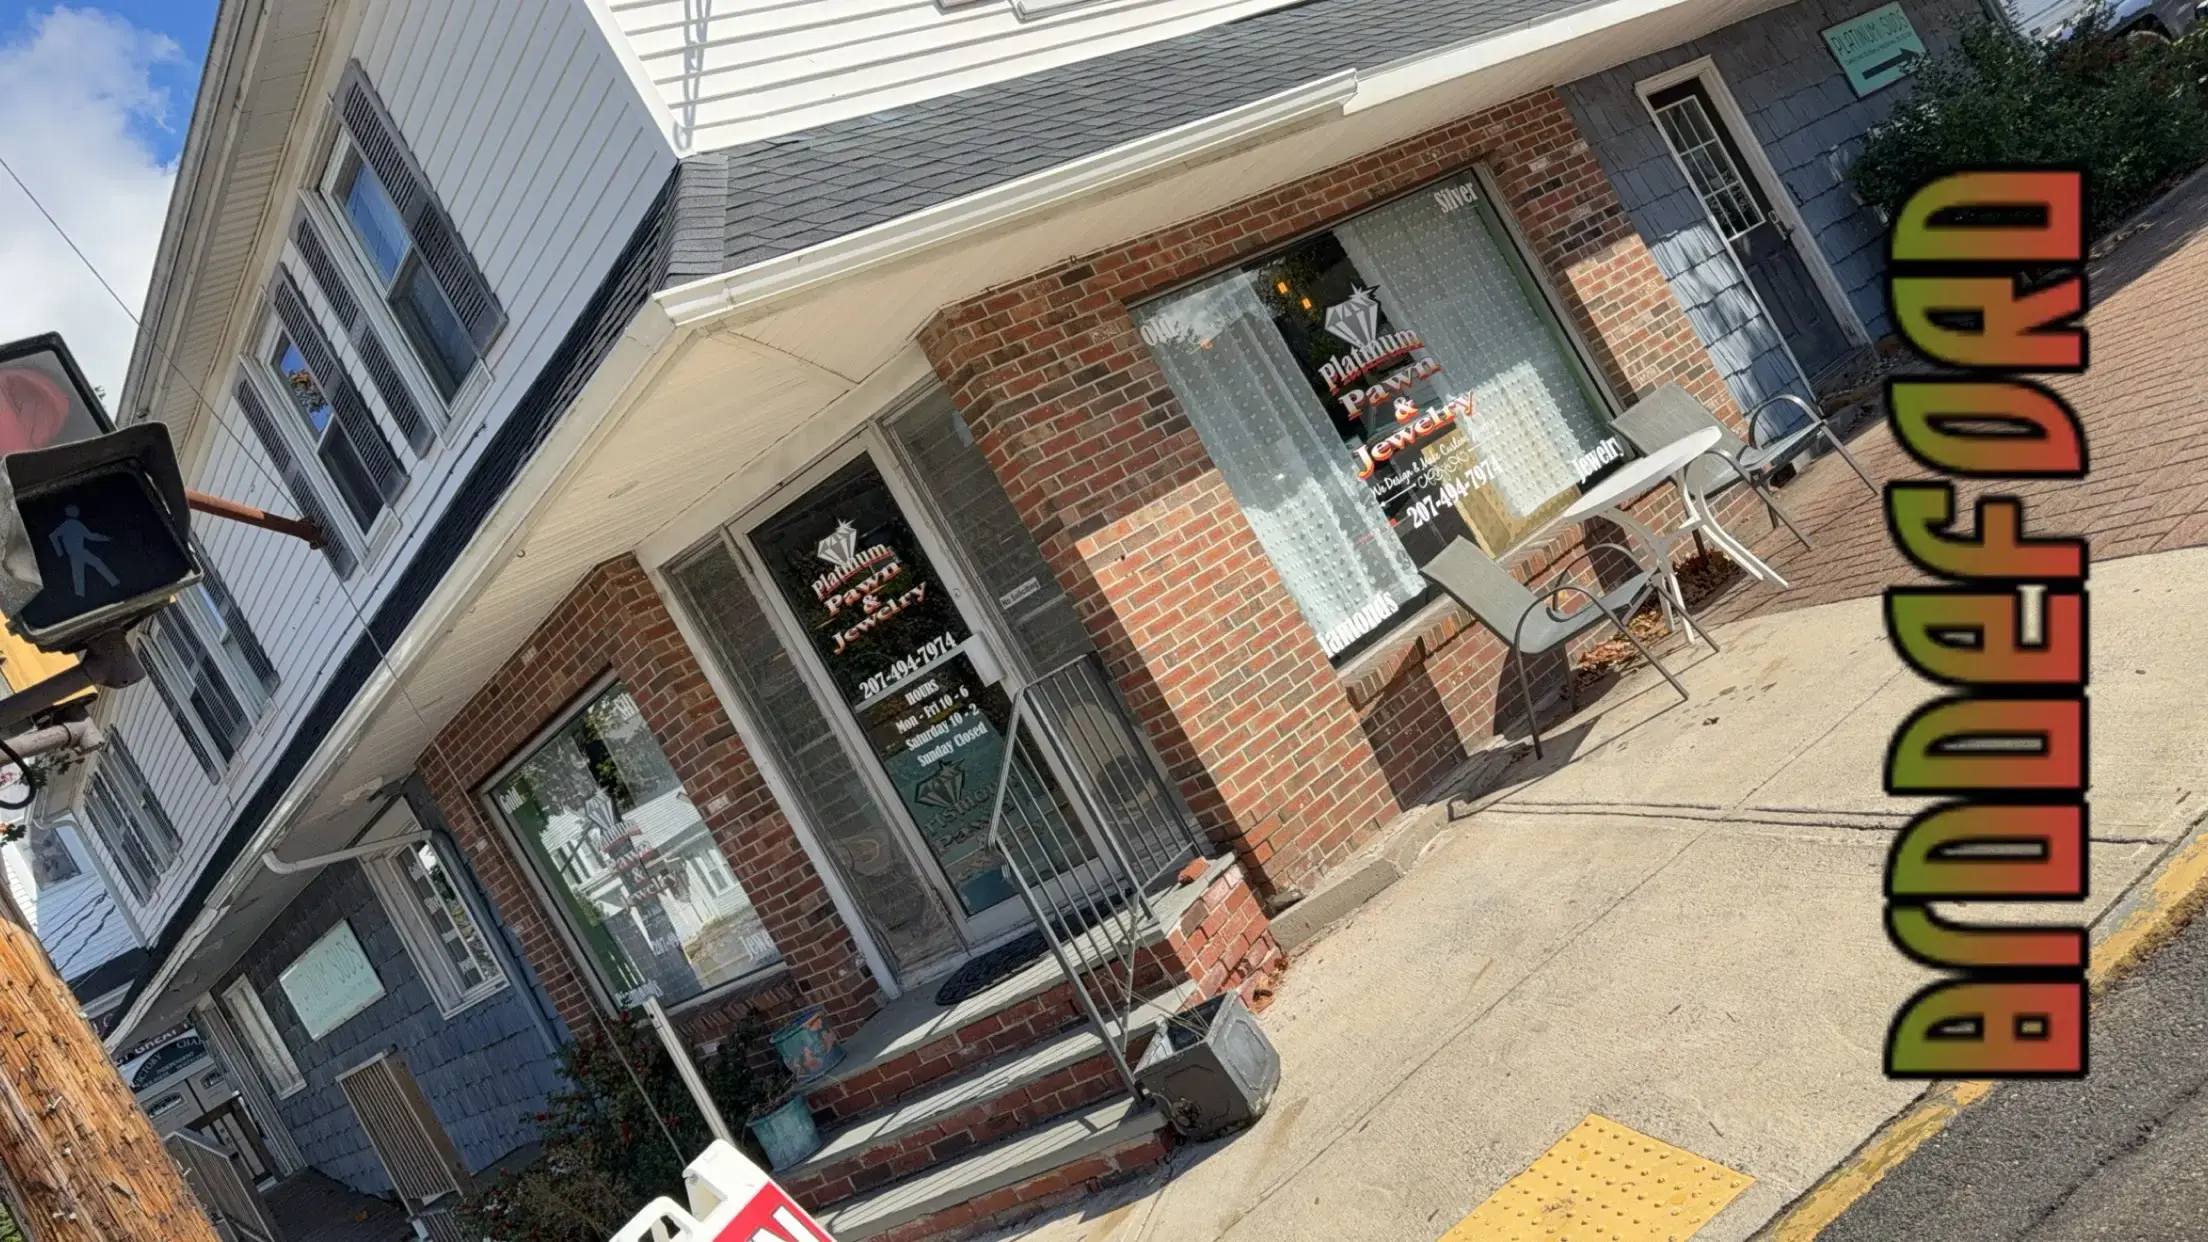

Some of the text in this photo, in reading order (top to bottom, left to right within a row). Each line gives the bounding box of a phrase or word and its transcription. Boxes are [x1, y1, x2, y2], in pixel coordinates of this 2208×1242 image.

[1831, 22, 1882, 56] PLATINUM
[1880, 9, 1909, 36] SUDS
[1433, 182, 1478, 213] Silver
[1318, 329, 1425, 395] Platinum
[1338, 356, 1442, 421] Pawn
[1394, 396, 1419, 424] &
[1353, 390, 1476, 480] Jewelry
[1384, 469, 1413, 493] Design
[1412, 461, 1420, 472] &
[1421, 453, 1441, 471] Make
[1406, 454, 1502, 529] 207-494-7974
[811, 543, 893, 600] Platinum
[824, 562, 903, 617] Pawn
[832, 581, 926, 656] Jewelry
[862, 594, 881, 614] &
[859, 631, 957, 700] 207-494-7974
[895, 715, 919, 735] Mon
[923, 701, 941, 719] Fri
[939, 694, 954, 711] 10
[960, 684, 969, 698] 6
[904, 679, 940, 706] HOURS
[905, 720, 950, 751] Saturday
[948, 712, 963, 728] 10
[968, 703, 980, 716] 2
[917, 721, 989, 767] Sunday Closed
[632, 867, 650, 884] &
[325, 934, 364, 984] SUDS
